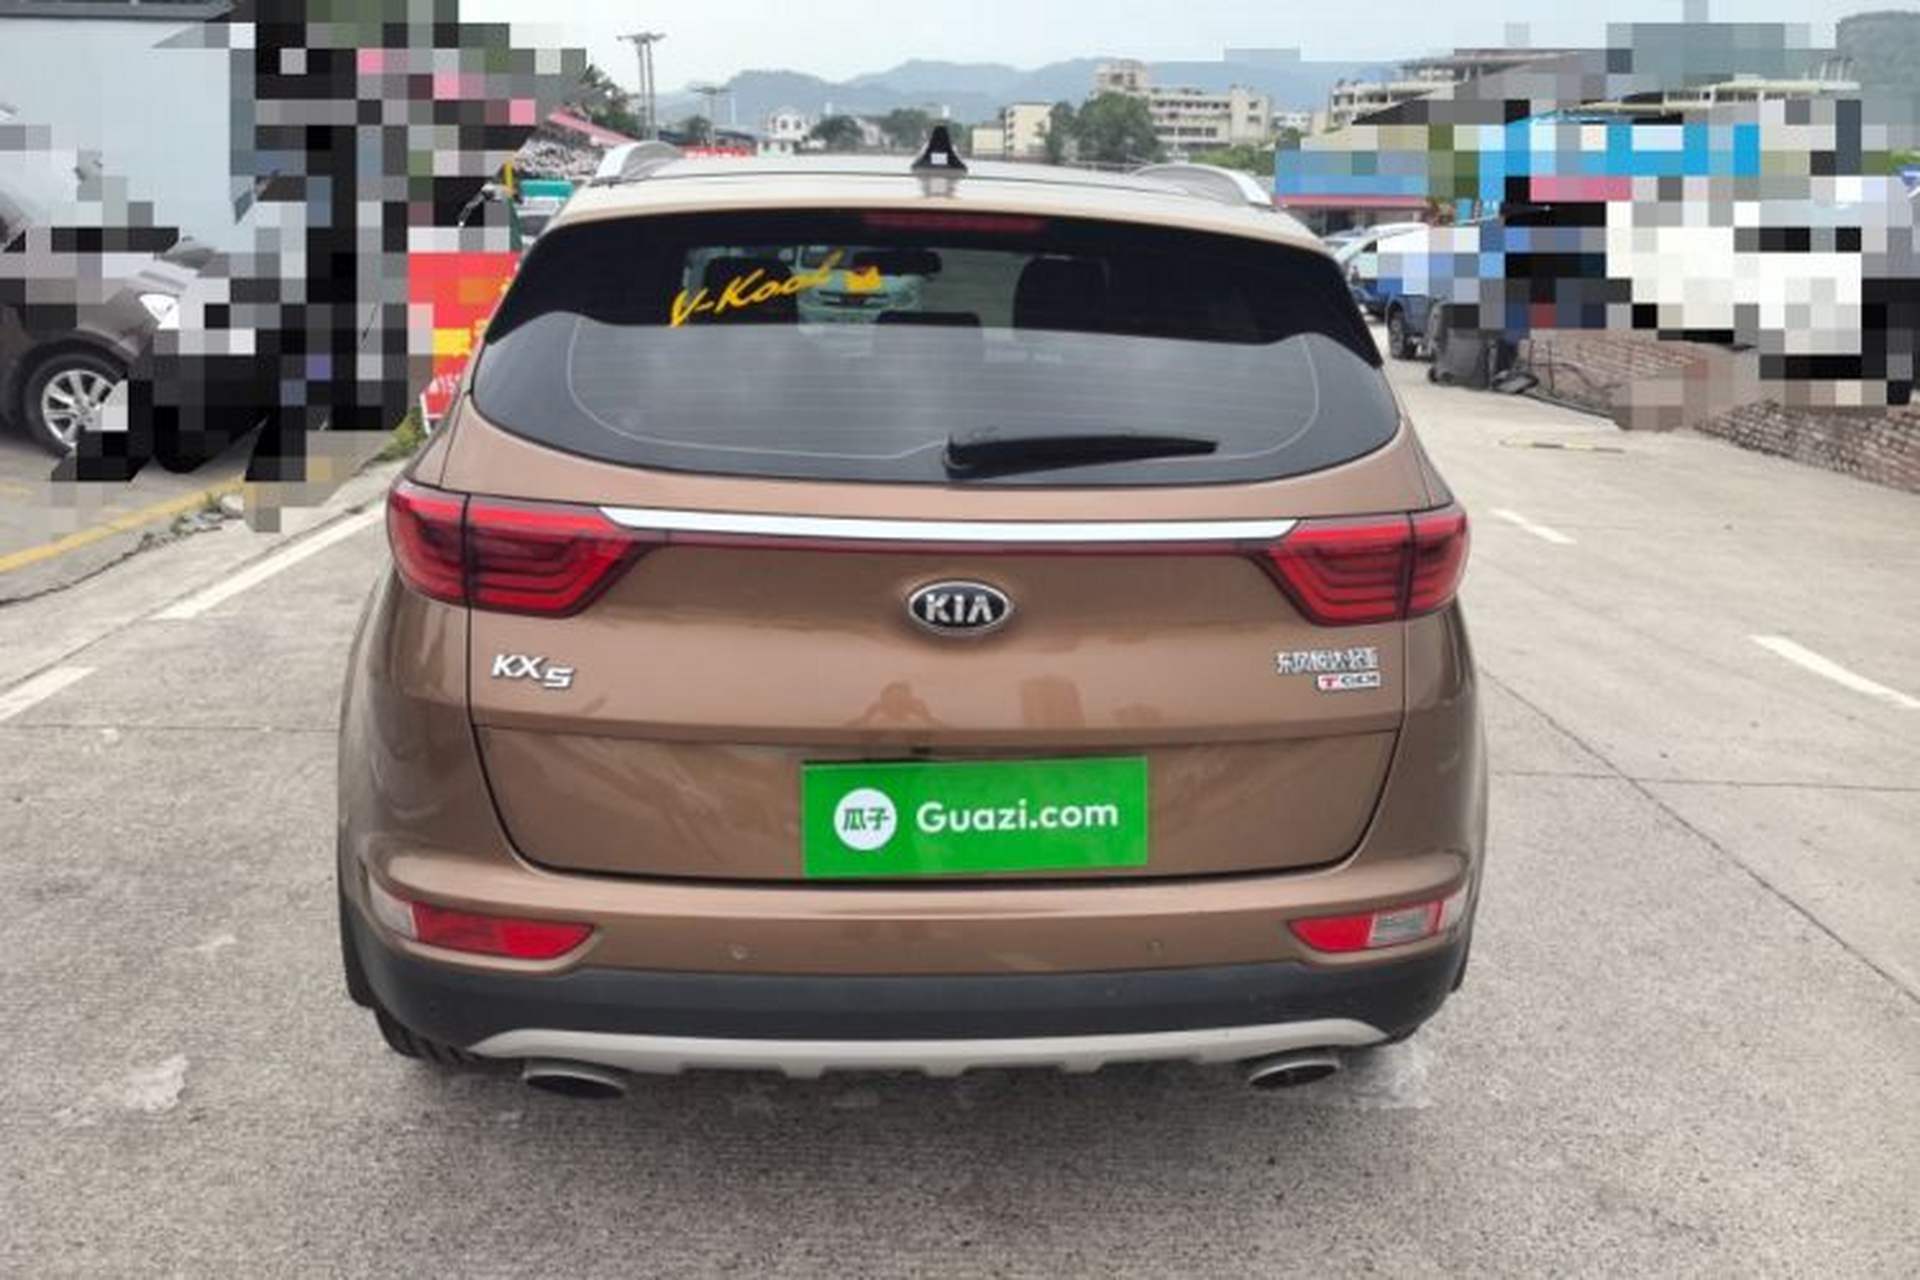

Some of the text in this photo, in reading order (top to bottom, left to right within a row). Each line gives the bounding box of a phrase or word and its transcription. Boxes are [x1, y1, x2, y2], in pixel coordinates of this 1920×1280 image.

[925, 593, 993, 623] KIA
[842, 806, 890, 833] 瓜子
[916, 799, 1118, 834] Guazi.com
